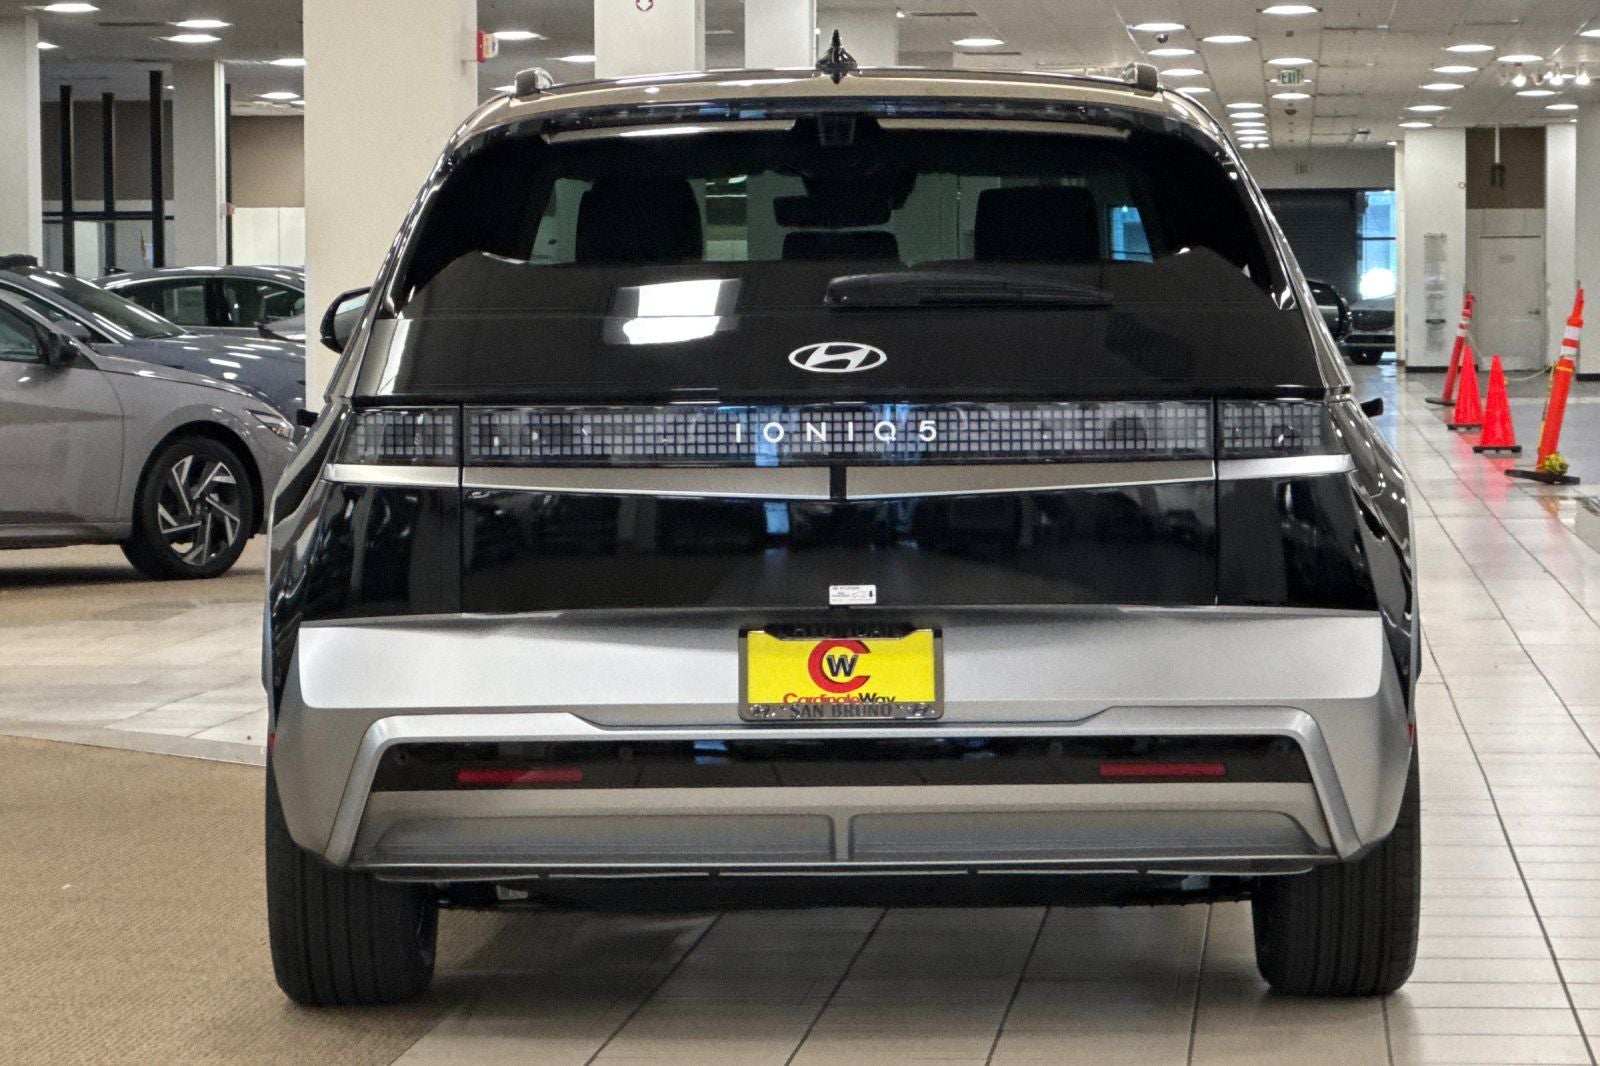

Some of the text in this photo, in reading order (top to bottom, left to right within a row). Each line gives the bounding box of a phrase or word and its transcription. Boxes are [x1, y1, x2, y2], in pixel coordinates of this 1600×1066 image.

[1281, 69, 1301, 84] EXIT
[735, 420, 937, 443] IONIQ 5
[791, 703, 892, 718] SAN BRUNO
